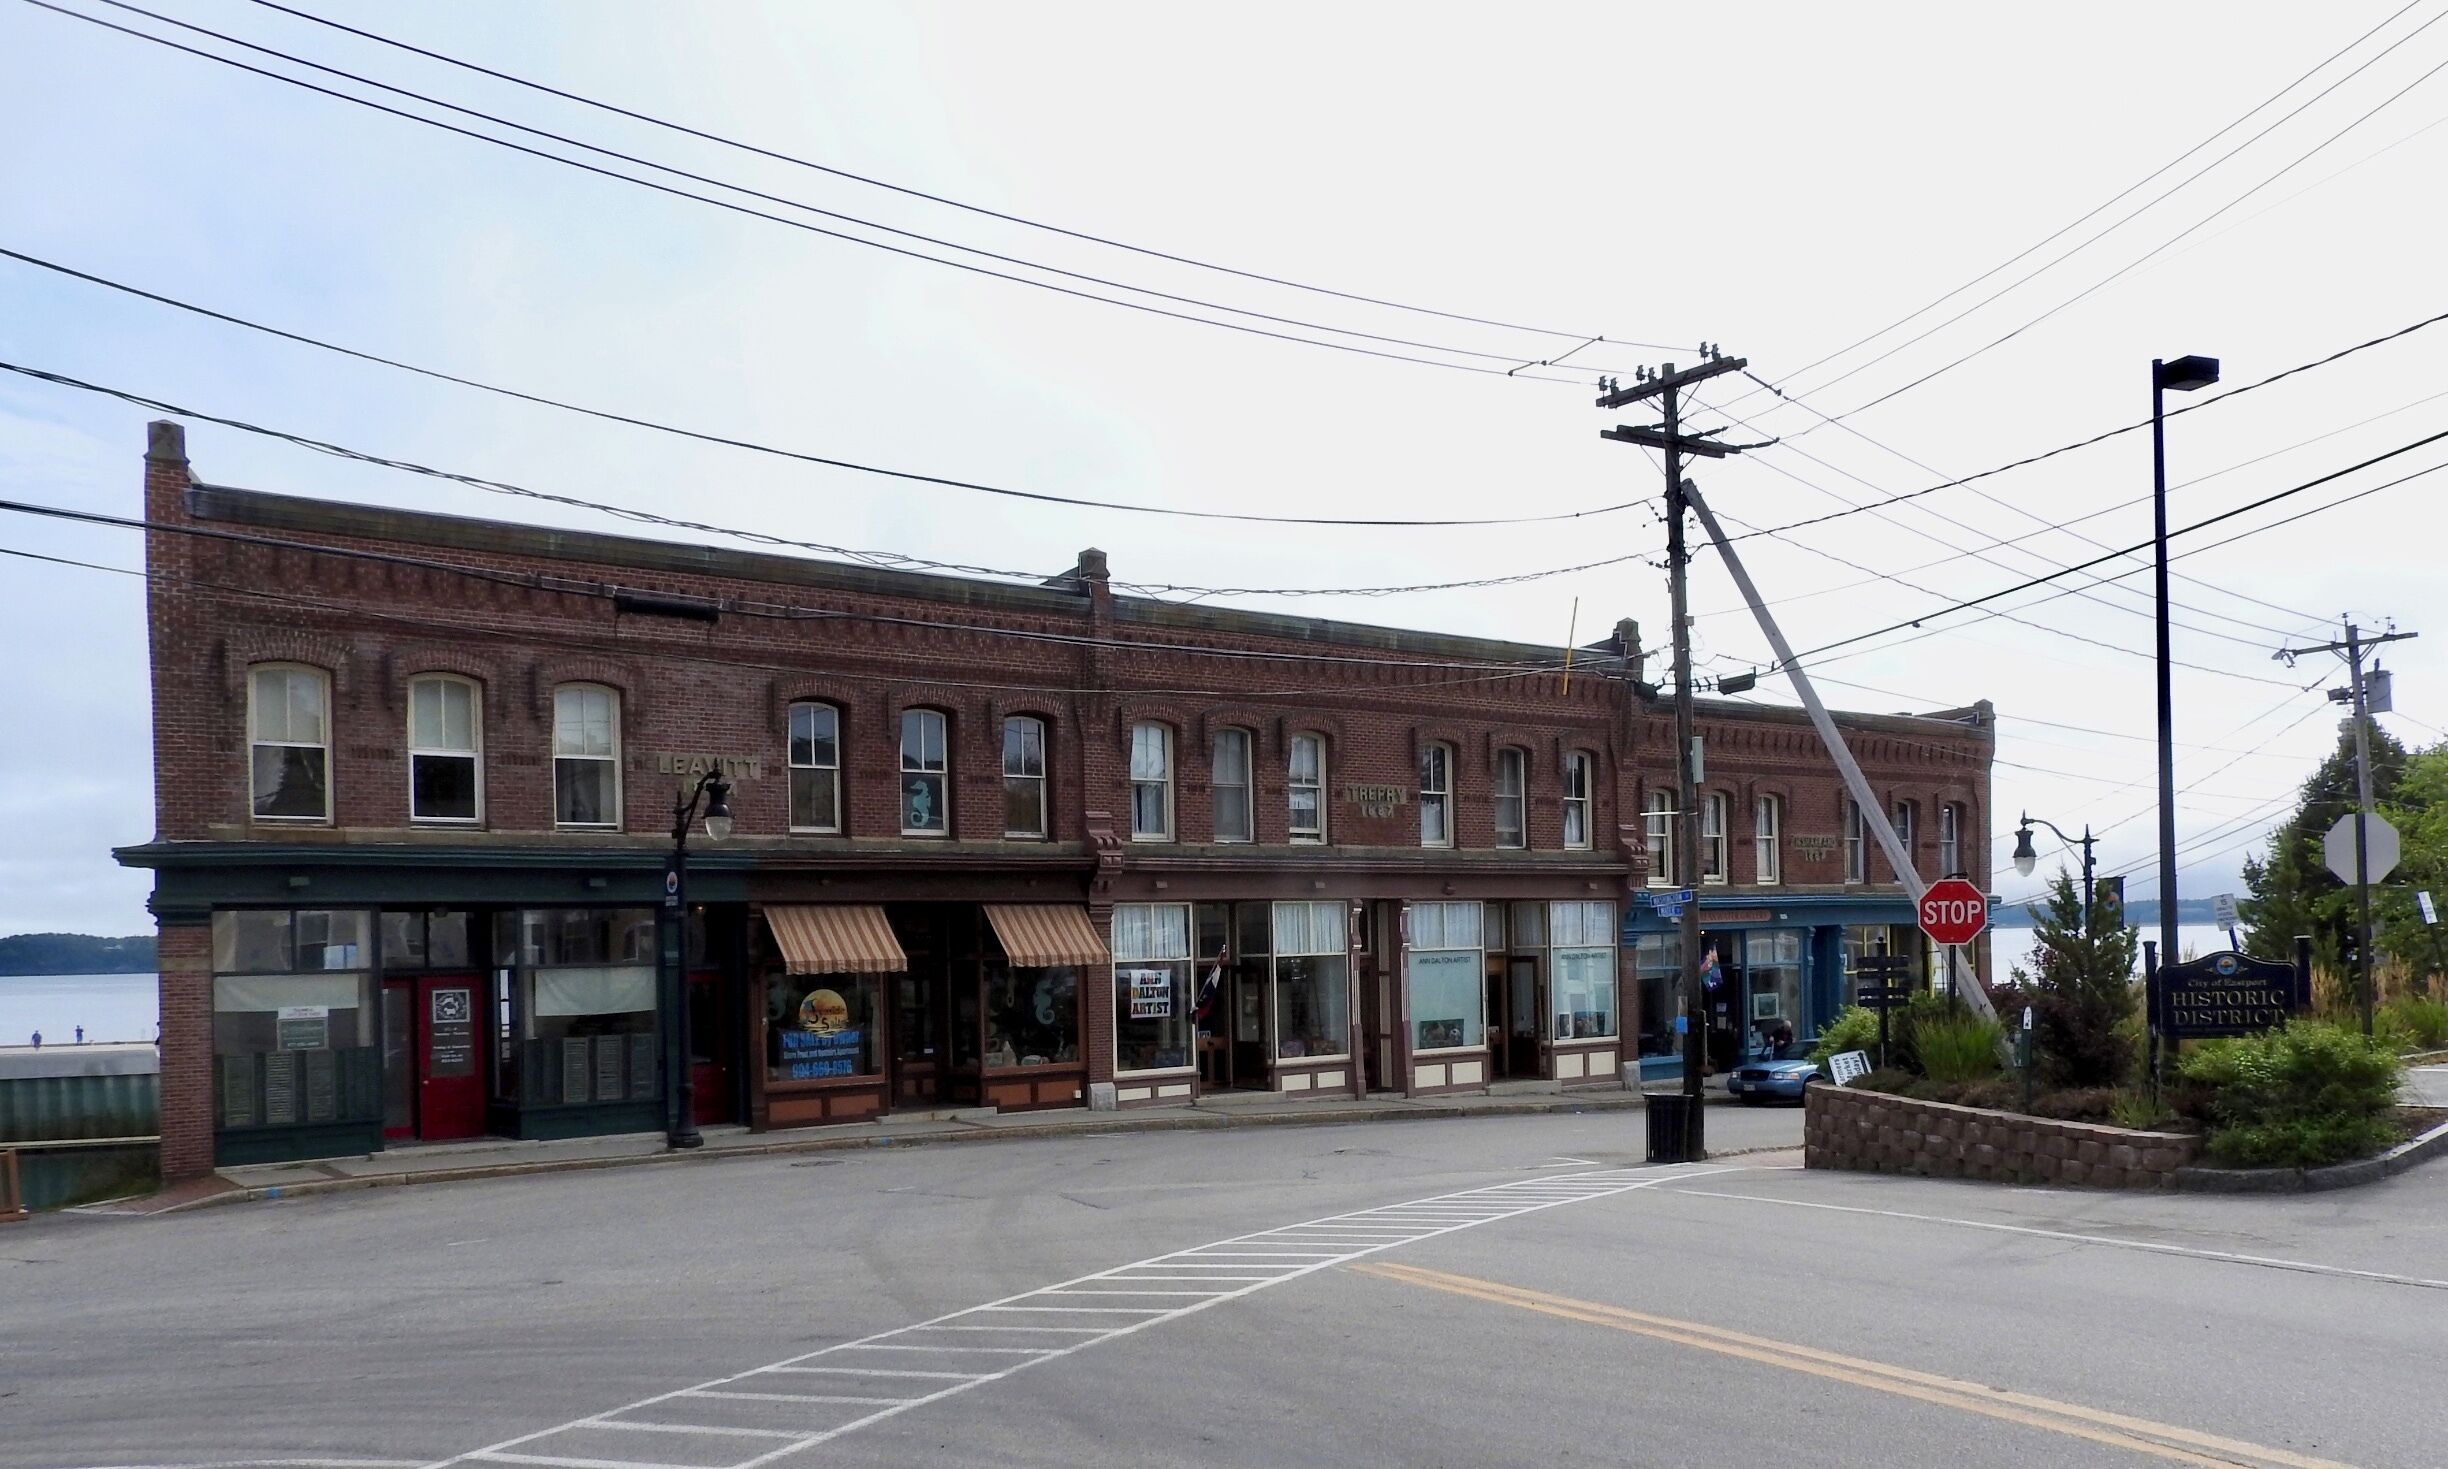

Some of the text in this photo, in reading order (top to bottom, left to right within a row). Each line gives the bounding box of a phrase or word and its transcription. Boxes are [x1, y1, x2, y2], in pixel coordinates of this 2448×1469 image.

[1923, 900, 1982, 925] STOP
[2187, 979, 2208, 988] City
[2211, 979, 2223, 987] of
[1132, 987, 1169, 998] DALTON
[2172, 991, 2285, 1007] HISTORIC
[1132, 1002, 1169, 1014] ARTIST
[2174, 1009, 2286, 1025] DISTRICT
